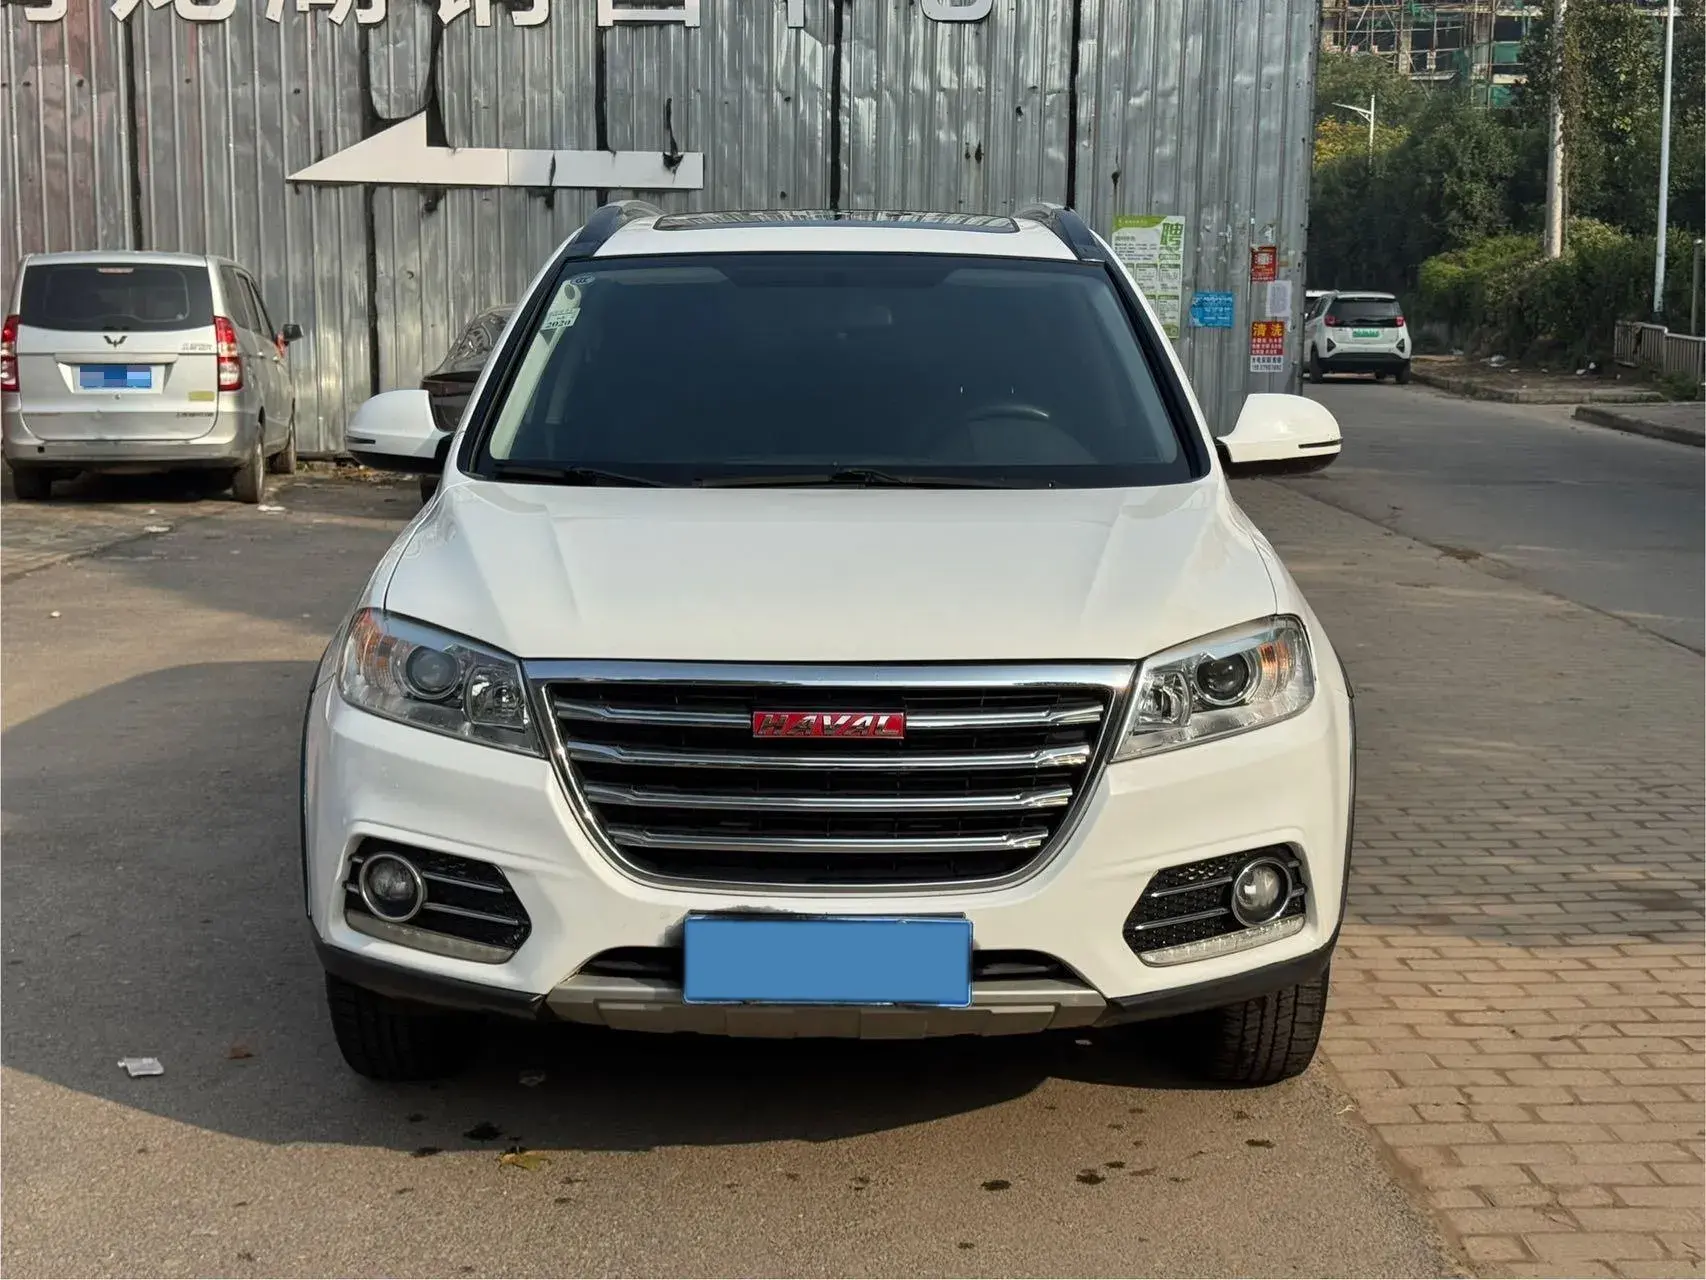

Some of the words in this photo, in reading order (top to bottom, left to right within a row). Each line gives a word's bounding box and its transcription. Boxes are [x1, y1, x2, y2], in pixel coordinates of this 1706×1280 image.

[1160, 222, 1184, 252] 聘
[545, 320, 571, 329] 2020
[1253, 323, 1283, 337] 清洗
[758, 714, 900, 736] HAVAL
